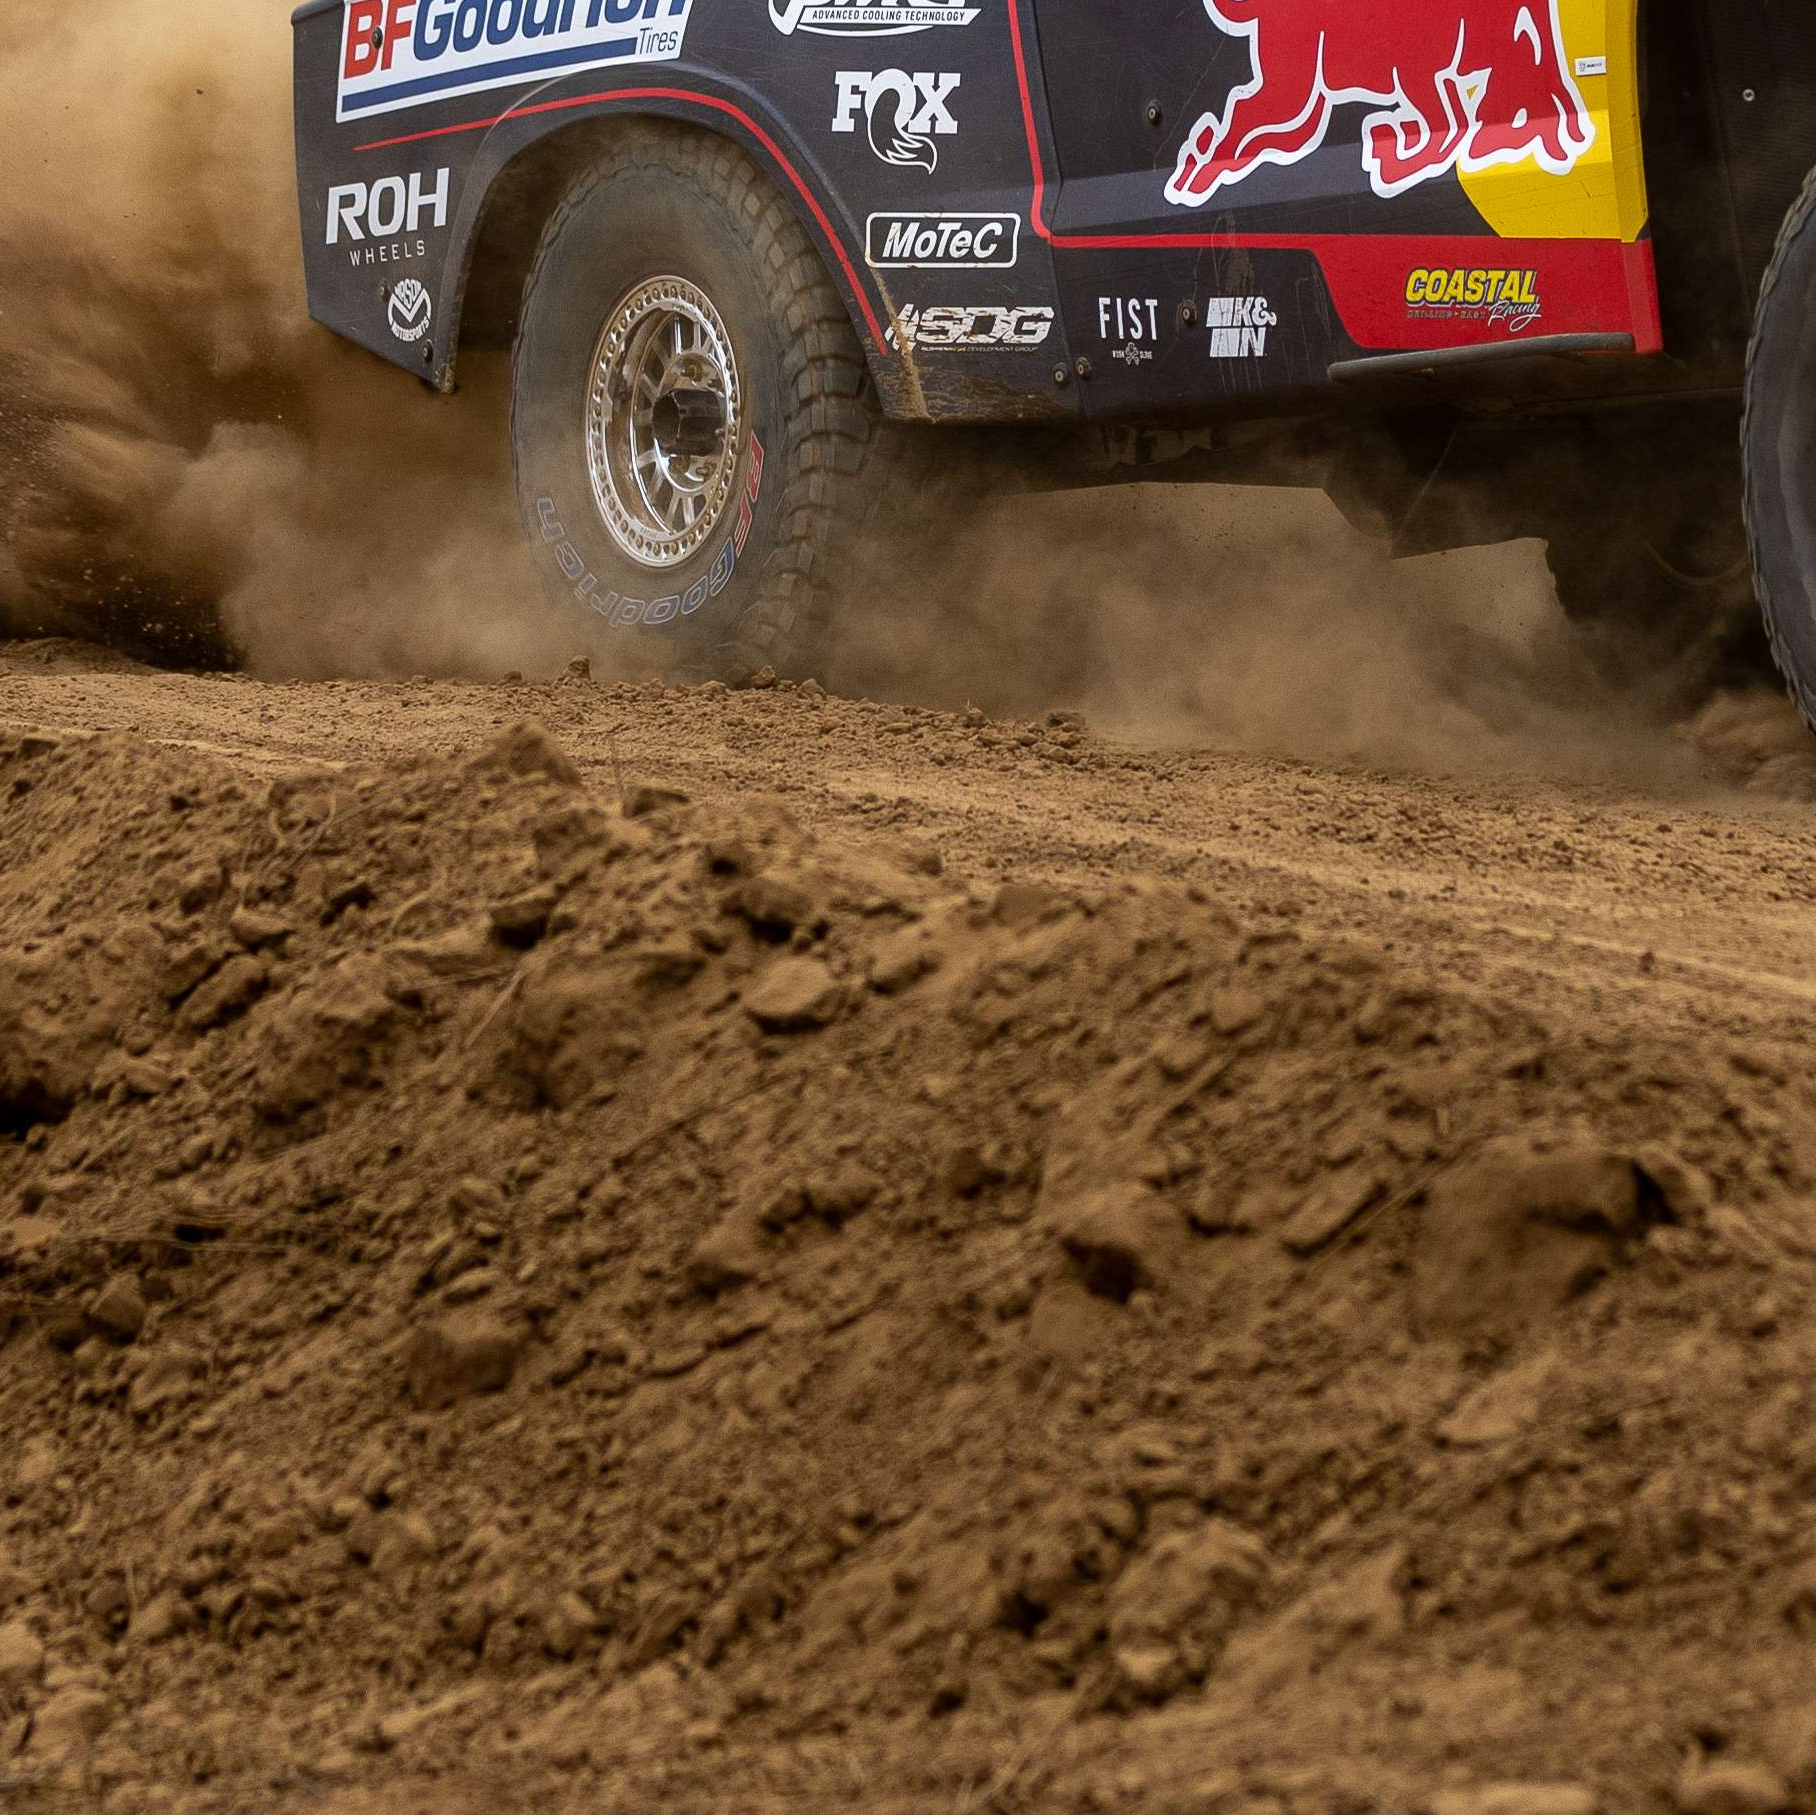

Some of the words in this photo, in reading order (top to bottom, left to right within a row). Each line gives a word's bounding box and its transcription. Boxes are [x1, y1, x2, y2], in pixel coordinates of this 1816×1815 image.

[812, 9, 860, 20] ADVANCED
[862, 10, 902, 21] COOLING
[905, 10, 965, 22] TECHNOLOGY
[639, 27, 679, 55] Tires
[831, 68, 961, 136] FOX
[325, 167, 450, 245] ROH
[349, 240, 426, 267] WHEELS
[882, 222, 1003, 259] MoTeC
[1405, 268, 1537, 305] COASTAL
[1098, 296, 1158, 341] FIST
[1488, 296, 1542, 332] Racing
